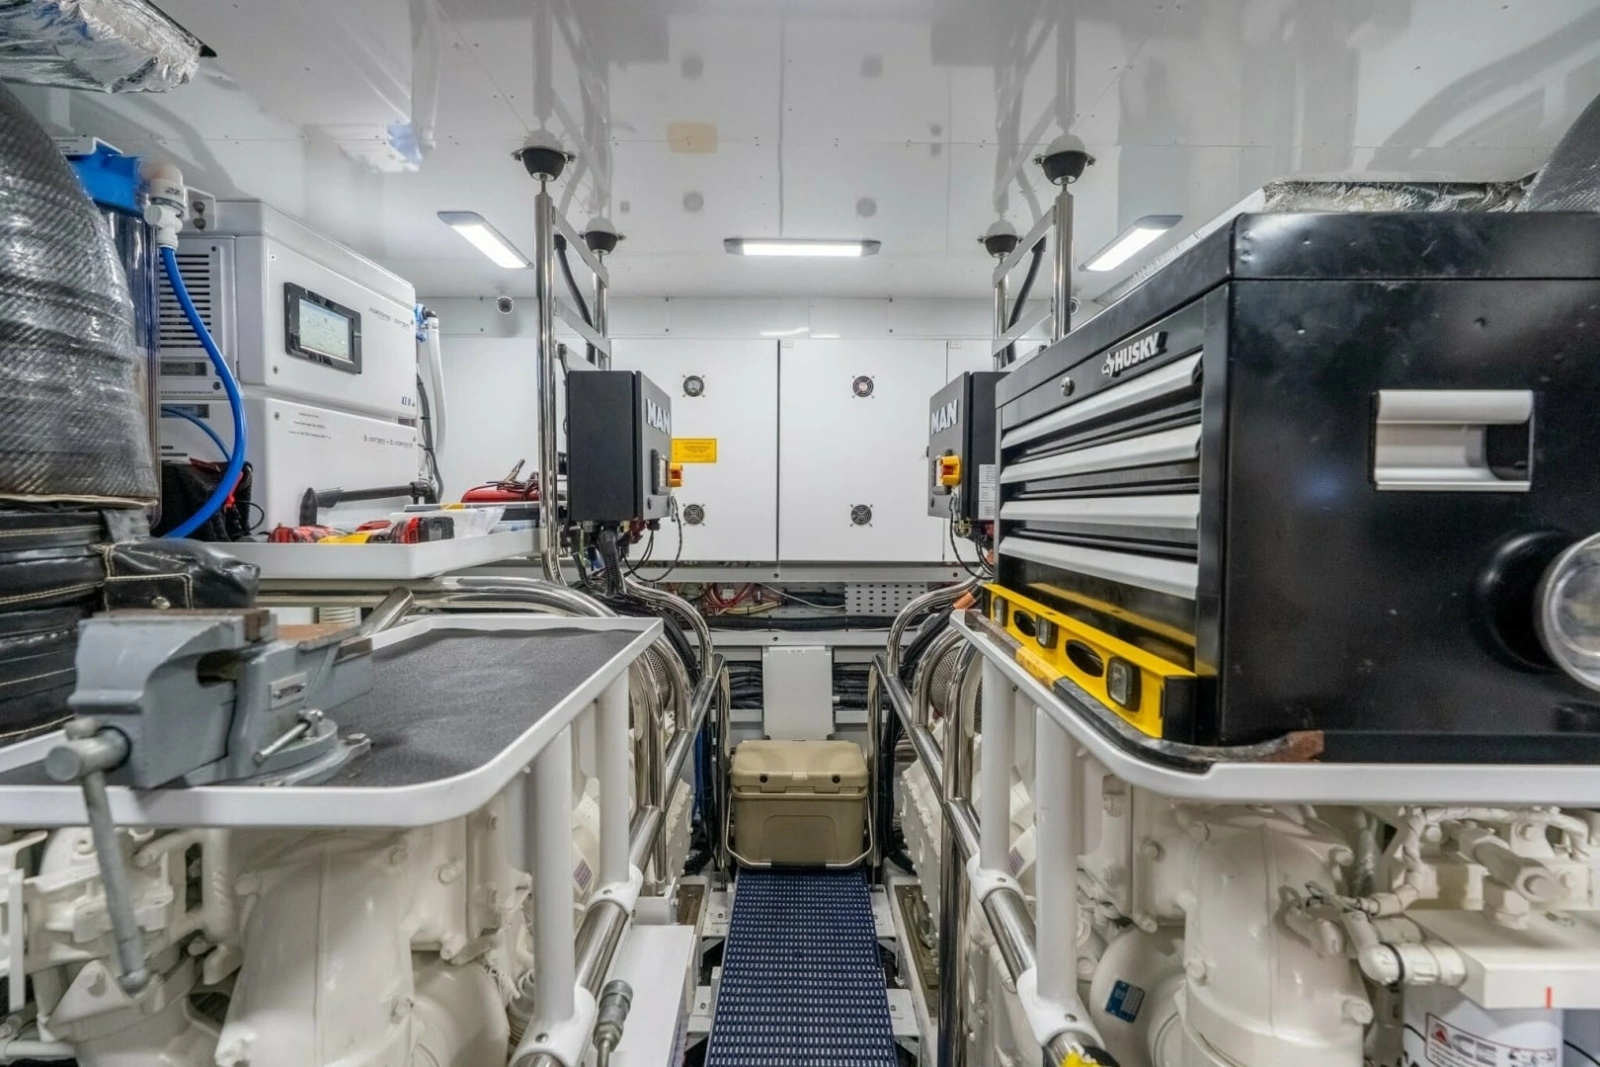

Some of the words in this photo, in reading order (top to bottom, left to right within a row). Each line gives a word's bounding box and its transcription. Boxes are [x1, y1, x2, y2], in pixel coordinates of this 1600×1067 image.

[1114, 332, 1159, 372] HUSKY
[647, 397, 670, 436] MAN
[932, 398, 958, 435] MAN
